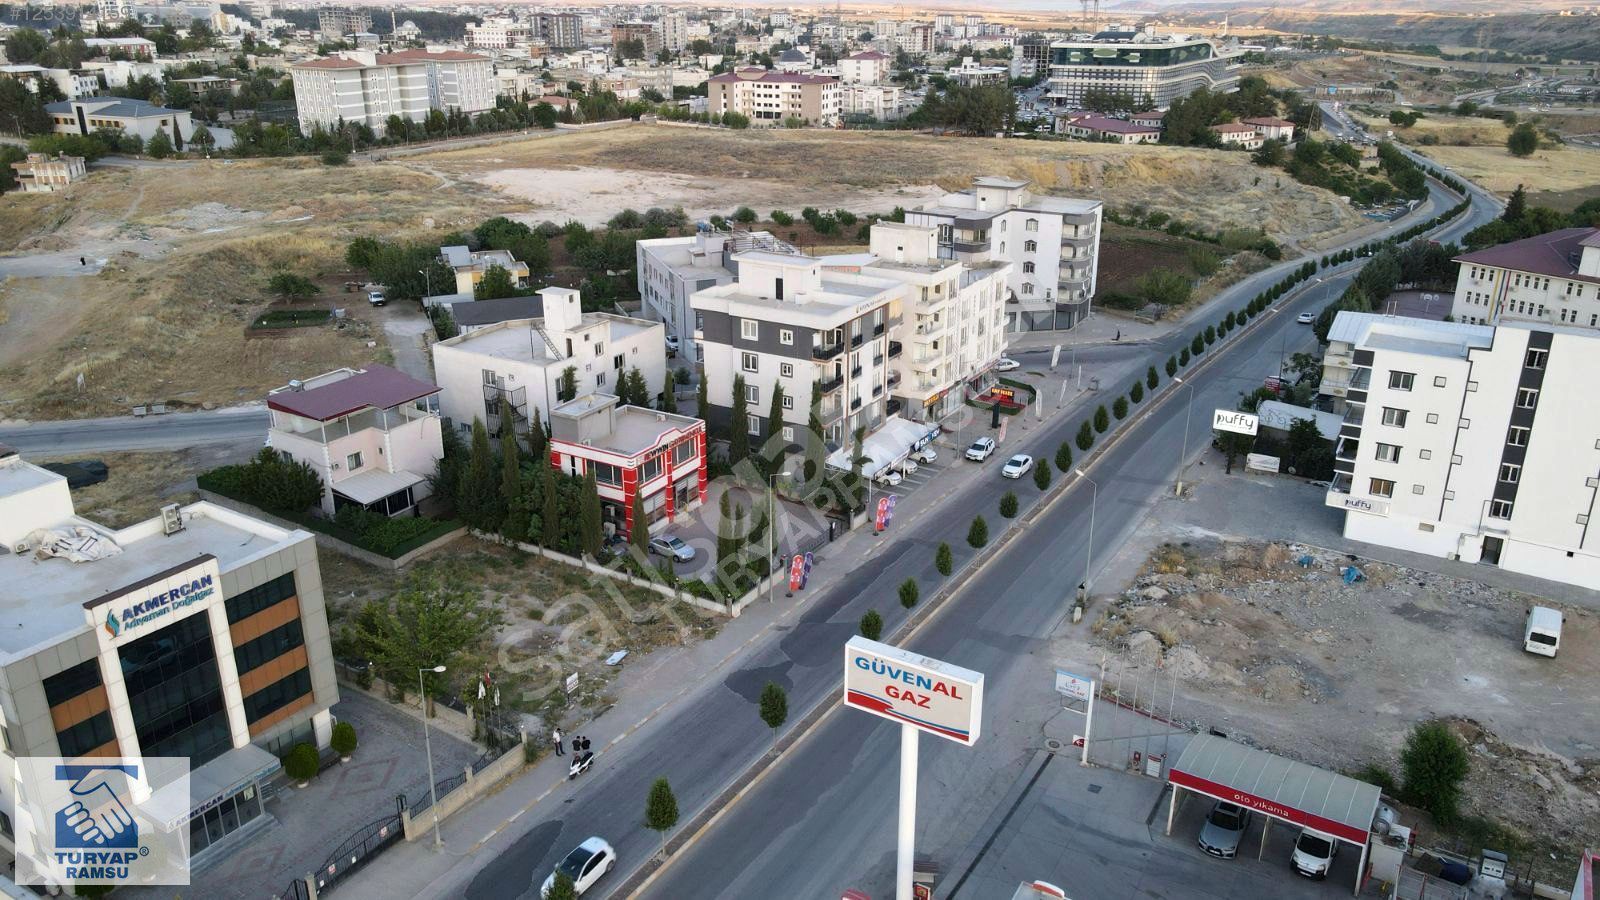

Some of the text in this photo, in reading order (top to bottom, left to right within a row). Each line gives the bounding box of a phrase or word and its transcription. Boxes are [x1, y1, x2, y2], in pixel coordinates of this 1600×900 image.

[1217, 414, 1254, 430] puffy
[1345, 499, 1372, 510] puffy
[122, 574, 213, 622] AKMERCAN
[855, 656, 963, 701] GÜVENAL
[885, 685, 931, 710] GAZ
[1234, 794, 1250, 803] oto
